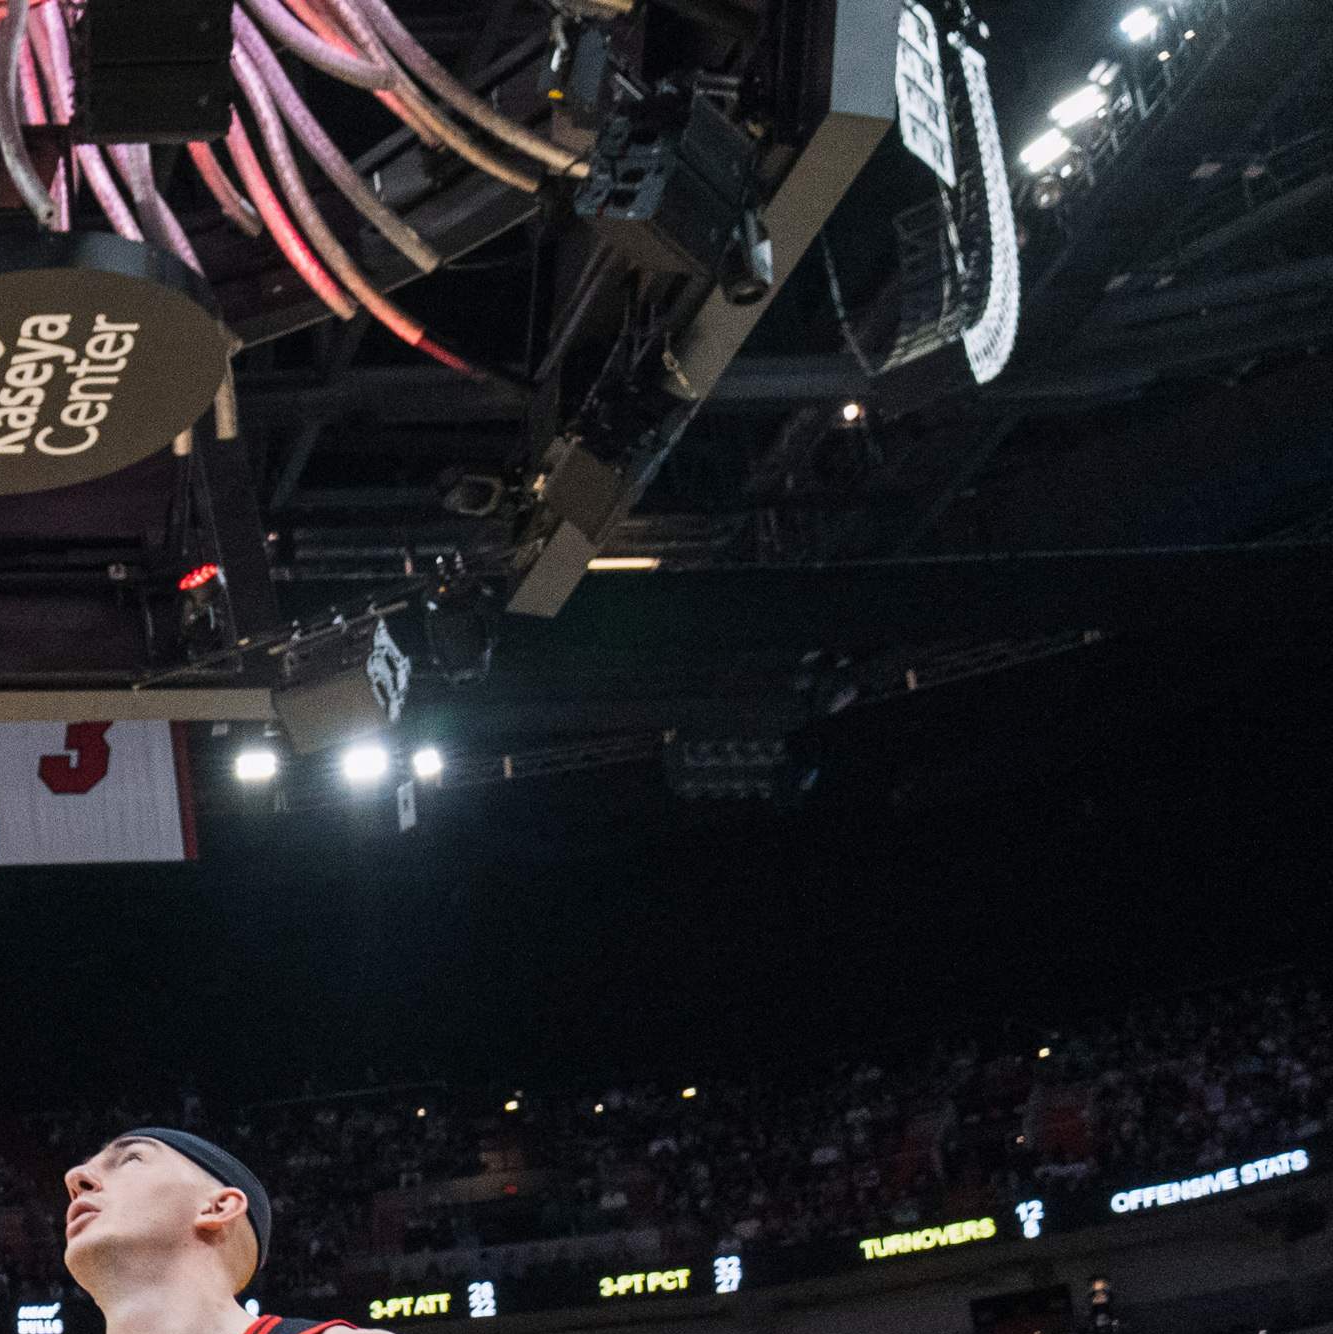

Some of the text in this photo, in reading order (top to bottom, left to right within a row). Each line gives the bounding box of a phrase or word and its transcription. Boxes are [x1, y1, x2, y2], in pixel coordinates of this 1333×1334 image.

[35, 313, 140, 456] Center
[1111, 1150, 1309, 1214] OFFENSIVE STATS
[860, 1217, 997, 1260] TURNOVERS
[599, 1268, 691, 1297] 3-PT PCT
[369, 1292, 451, 1320] 3-PT ATT
